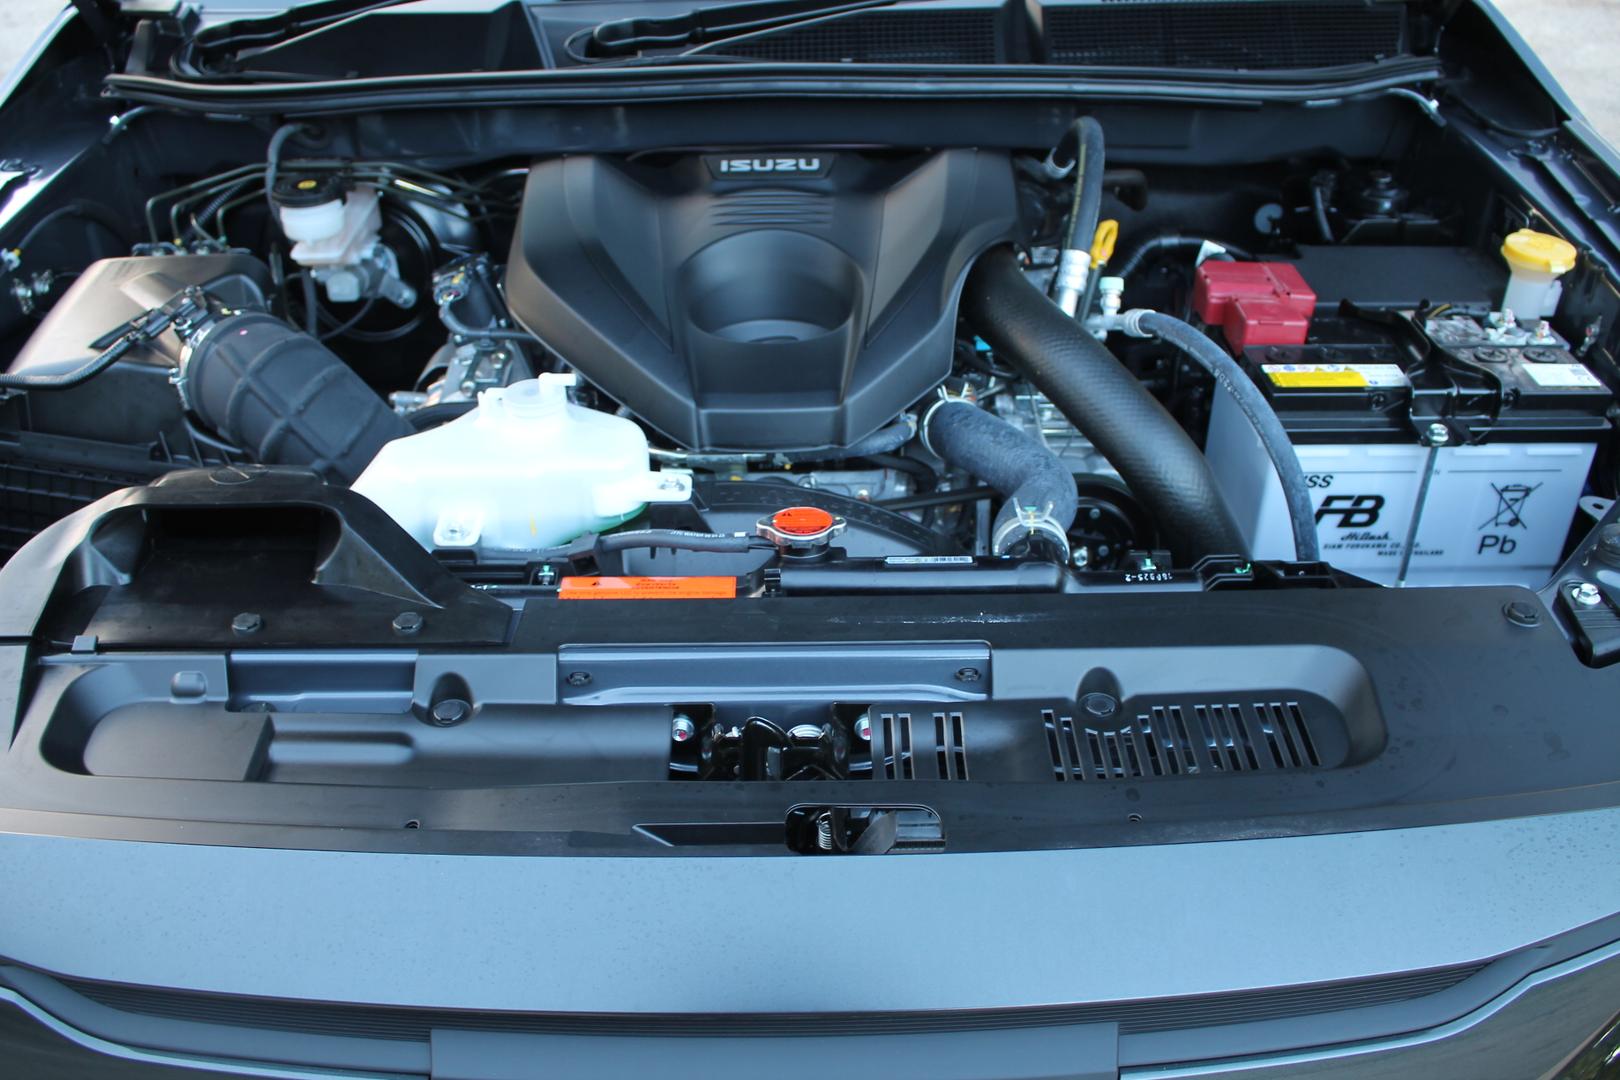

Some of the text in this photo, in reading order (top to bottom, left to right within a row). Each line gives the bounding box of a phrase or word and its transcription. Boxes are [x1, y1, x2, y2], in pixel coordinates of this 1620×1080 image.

[720, 159, 820, 173] ISUZU
[1304, 474, 1334, 488] SS
[1315, 495, 1385, 528] FB
[1477, 534, 1517, 555] Pb
[1413, 549, 1445, 557] HAILAND
